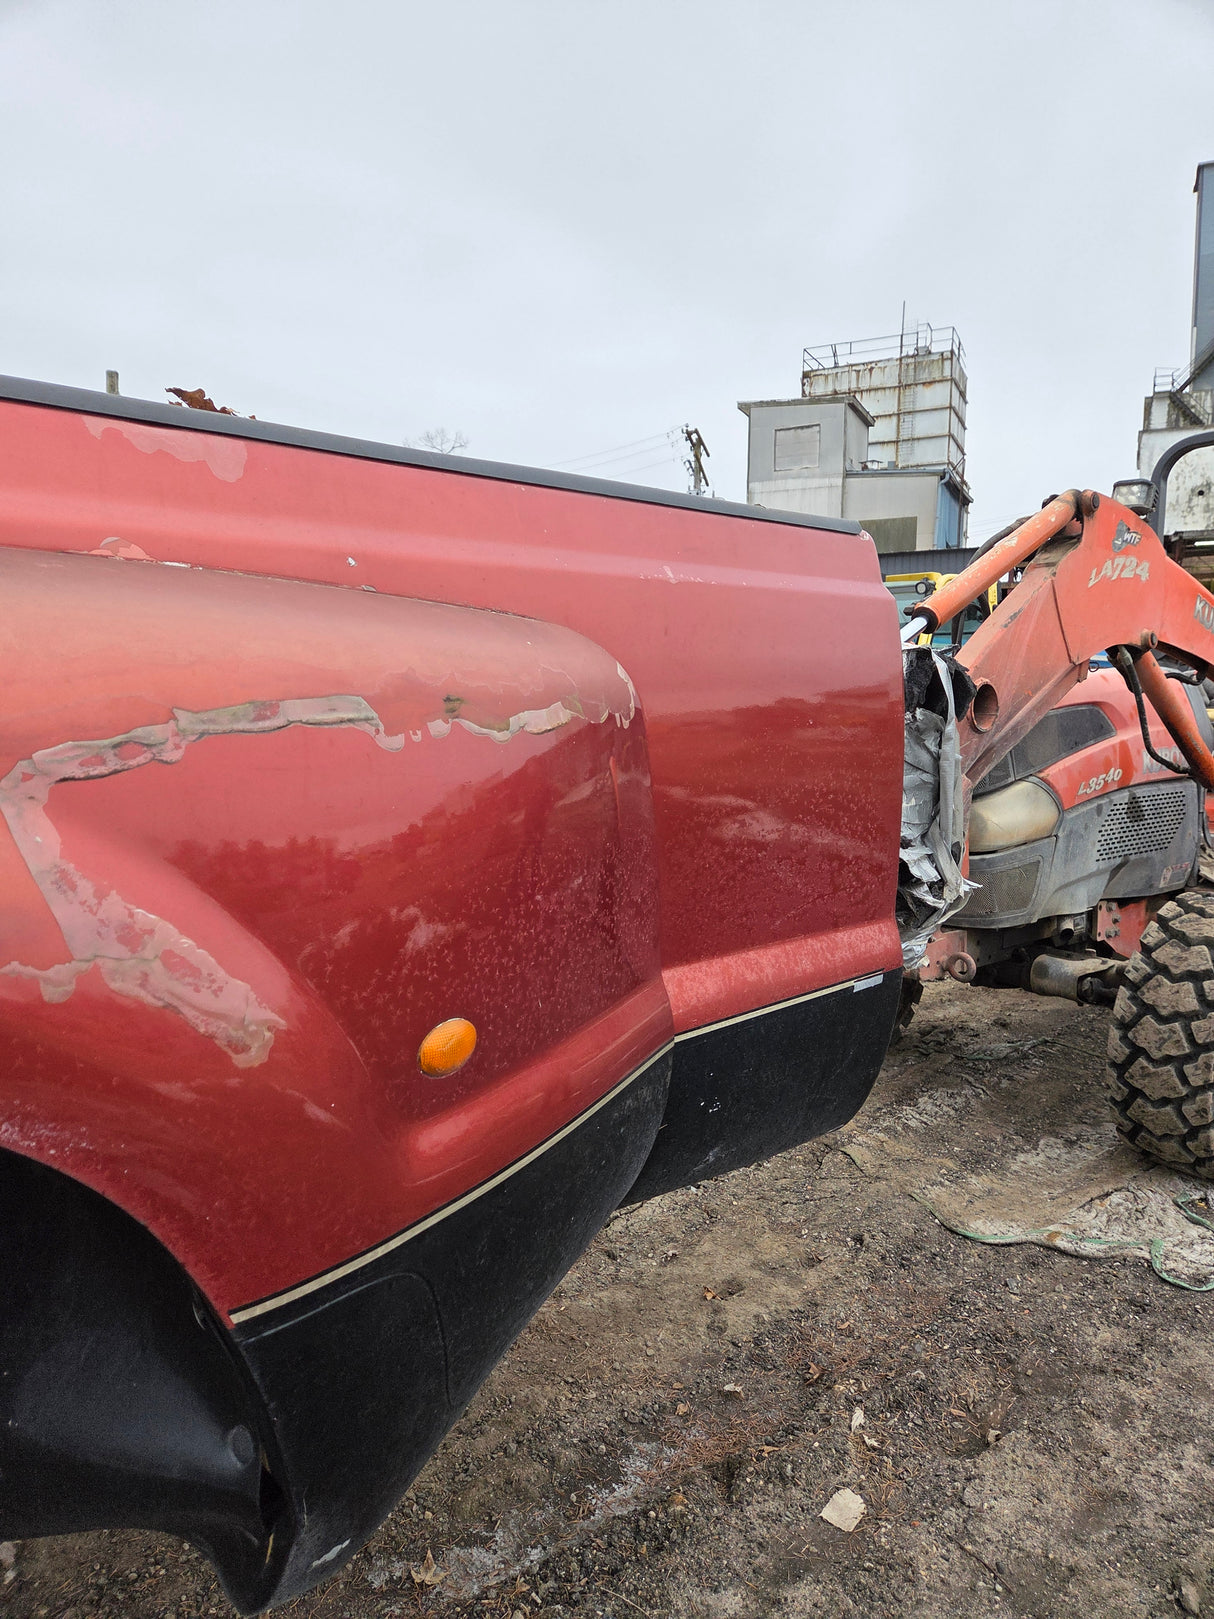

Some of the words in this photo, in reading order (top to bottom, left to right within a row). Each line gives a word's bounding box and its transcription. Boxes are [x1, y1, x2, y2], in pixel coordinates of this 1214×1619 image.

[1087, 555, 1150, 588] LA724
[1194, 593, 1214, 634] KU
[1077, 767, 1123, 796] L3540
